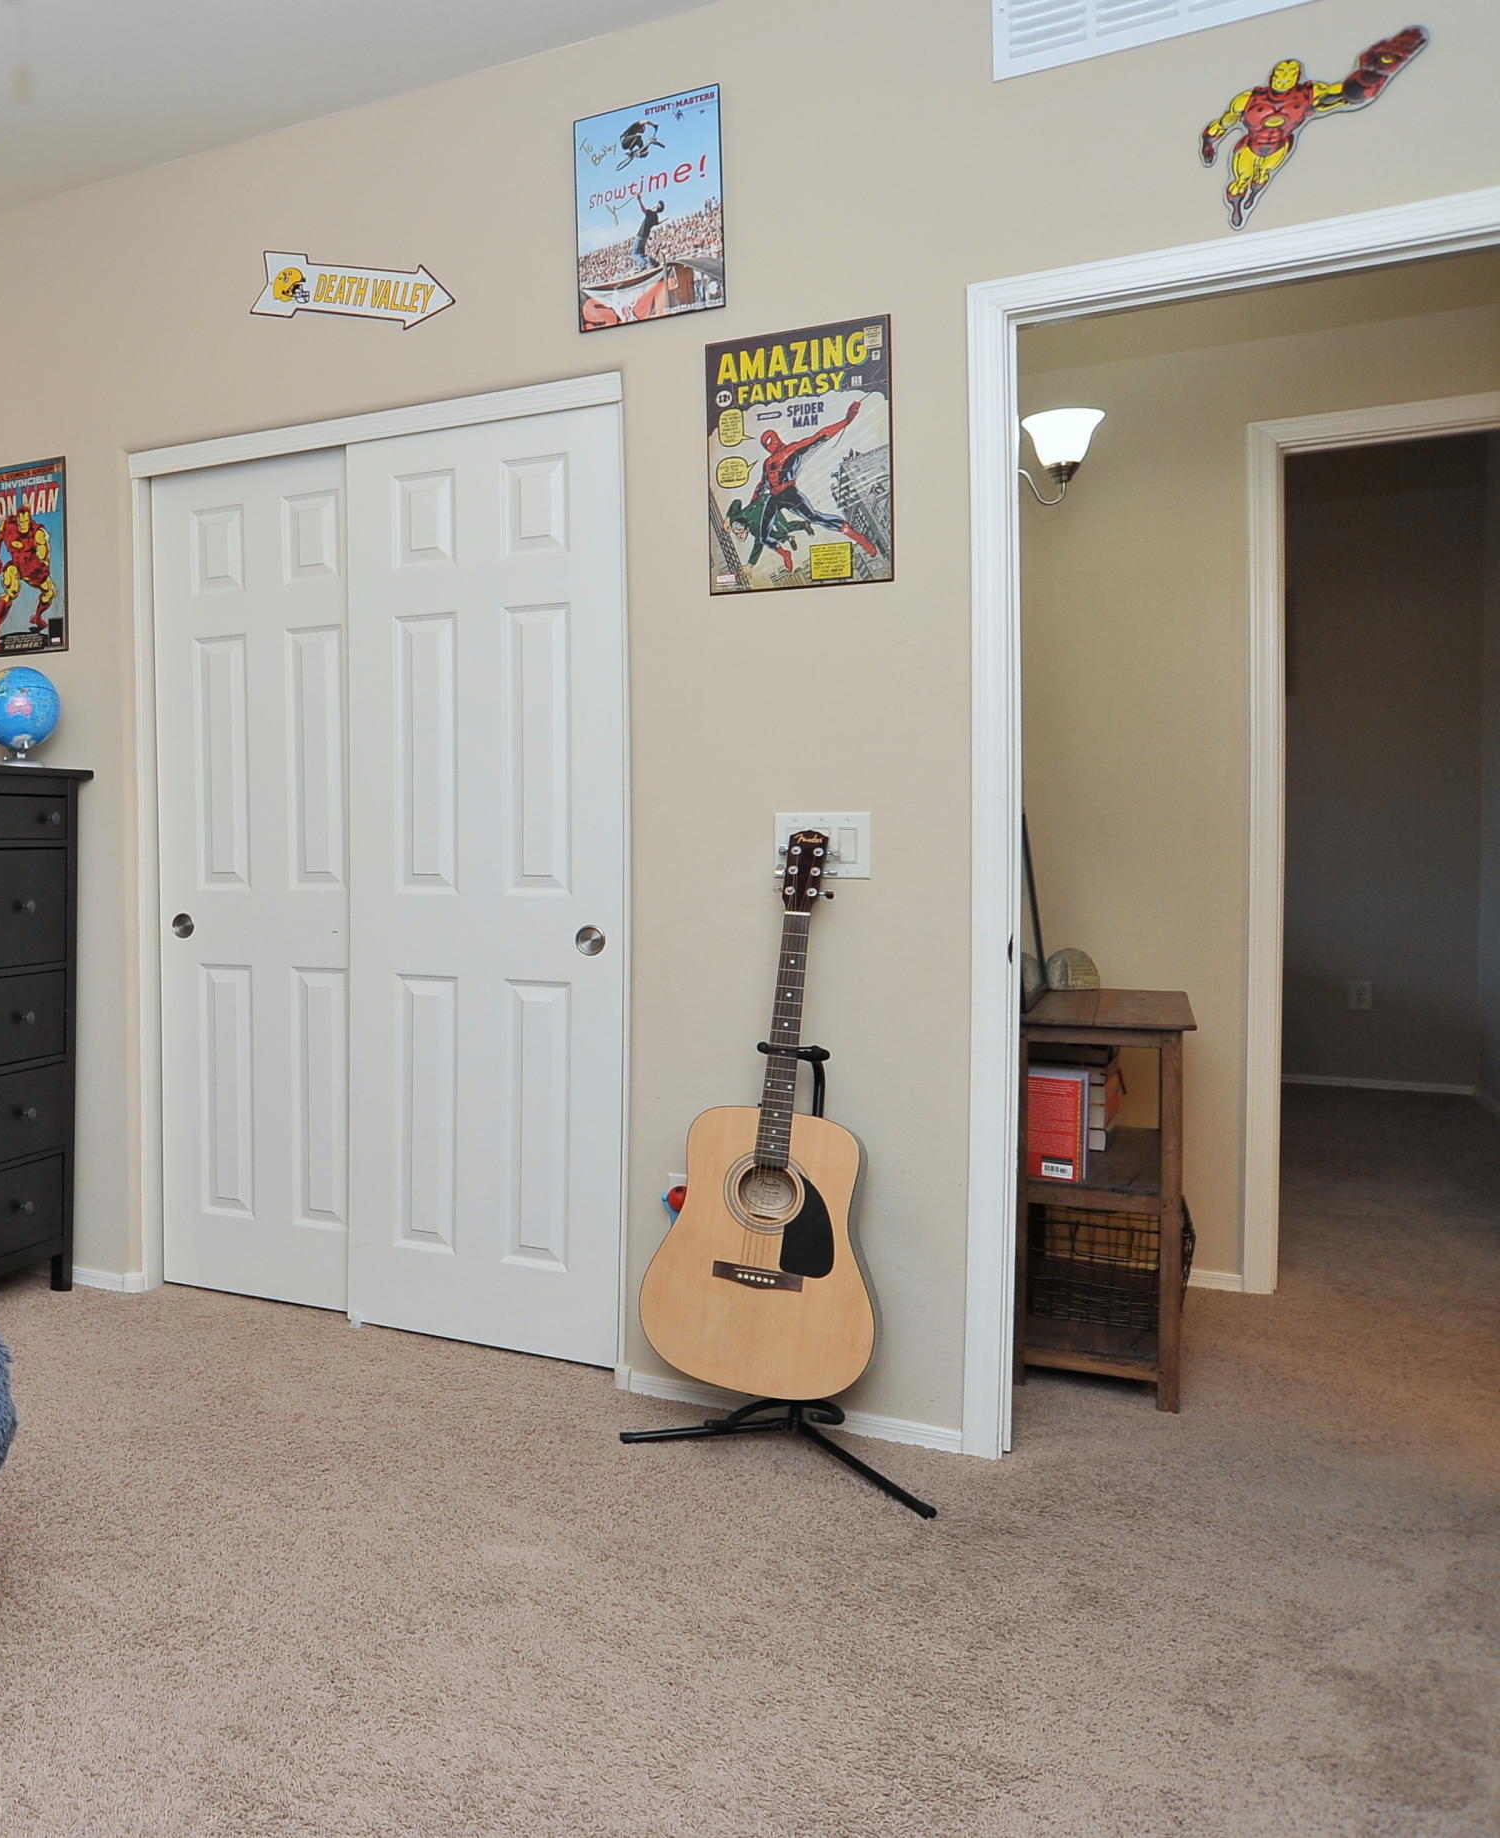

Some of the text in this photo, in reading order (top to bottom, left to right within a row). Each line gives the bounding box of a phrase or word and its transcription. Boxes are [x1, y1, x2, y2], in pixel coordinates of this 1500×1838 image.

[313, 273, 436, 314] DEATH VALLEY
[717, 331, 868, 385] AMAZING
[738, 371, 845, 405] FANTASY
[786, 401, 825, 418] SPIDER
[793, 413, 818, 429] MAN
[1, 474, 53, 490] INVINCIBLE
[22, 486, 59, 515] MAN
[793, 833, 825, 844] Fender
